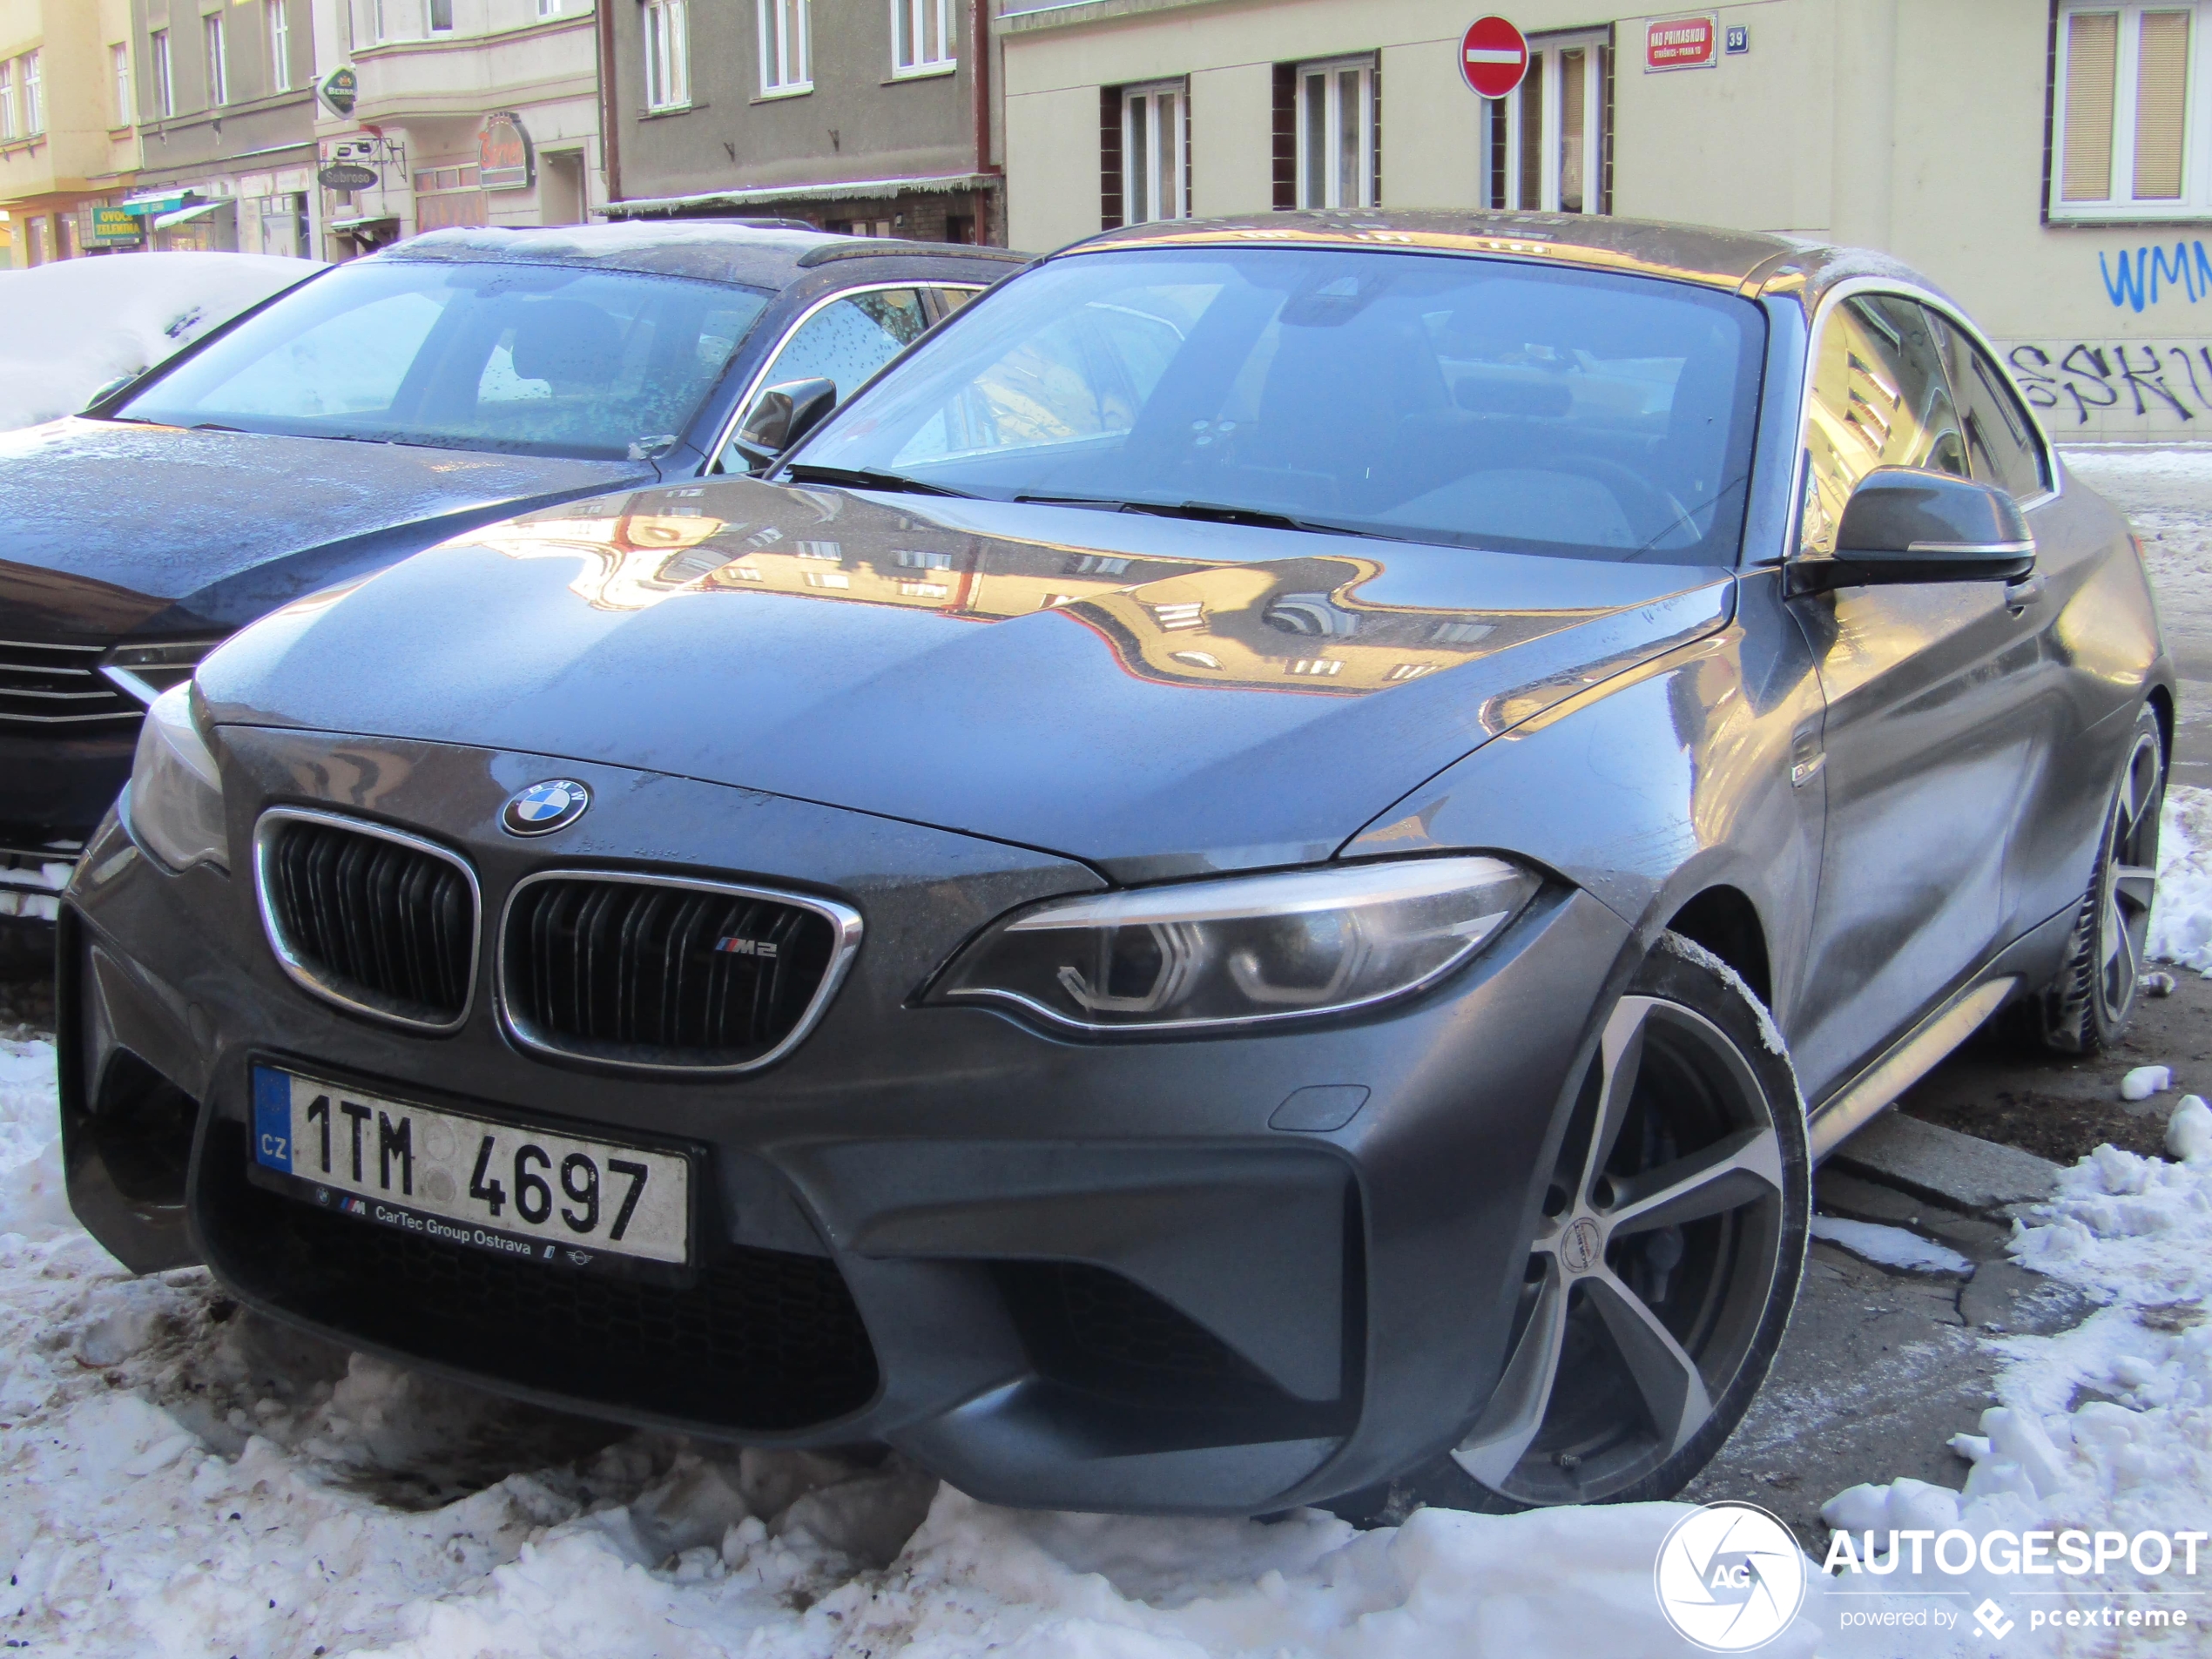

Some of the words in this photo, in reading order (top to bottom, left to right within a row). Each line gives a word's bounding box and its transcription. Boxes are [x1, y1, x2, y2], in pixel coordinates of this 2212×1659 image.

[1651, 31, 1662, 47] NAD
[1664, 28, 1705, 45] PRIMASKOU
[1729, 32, 1743, 46] 39
[1679, 47, 1695, 56] PRAHA
[1695, 46, 1701, 55] 10
[262, 1134, 287, 1160] CZ
[308, 1095, 412, 1195] 1TM
[470, 1136, 648, 1240] 4697
[375, 1205, 424, 1231] CarTec
[426, 1219, 471, 1244] Group
[474, 1230, 532, 1256] Ostrava
